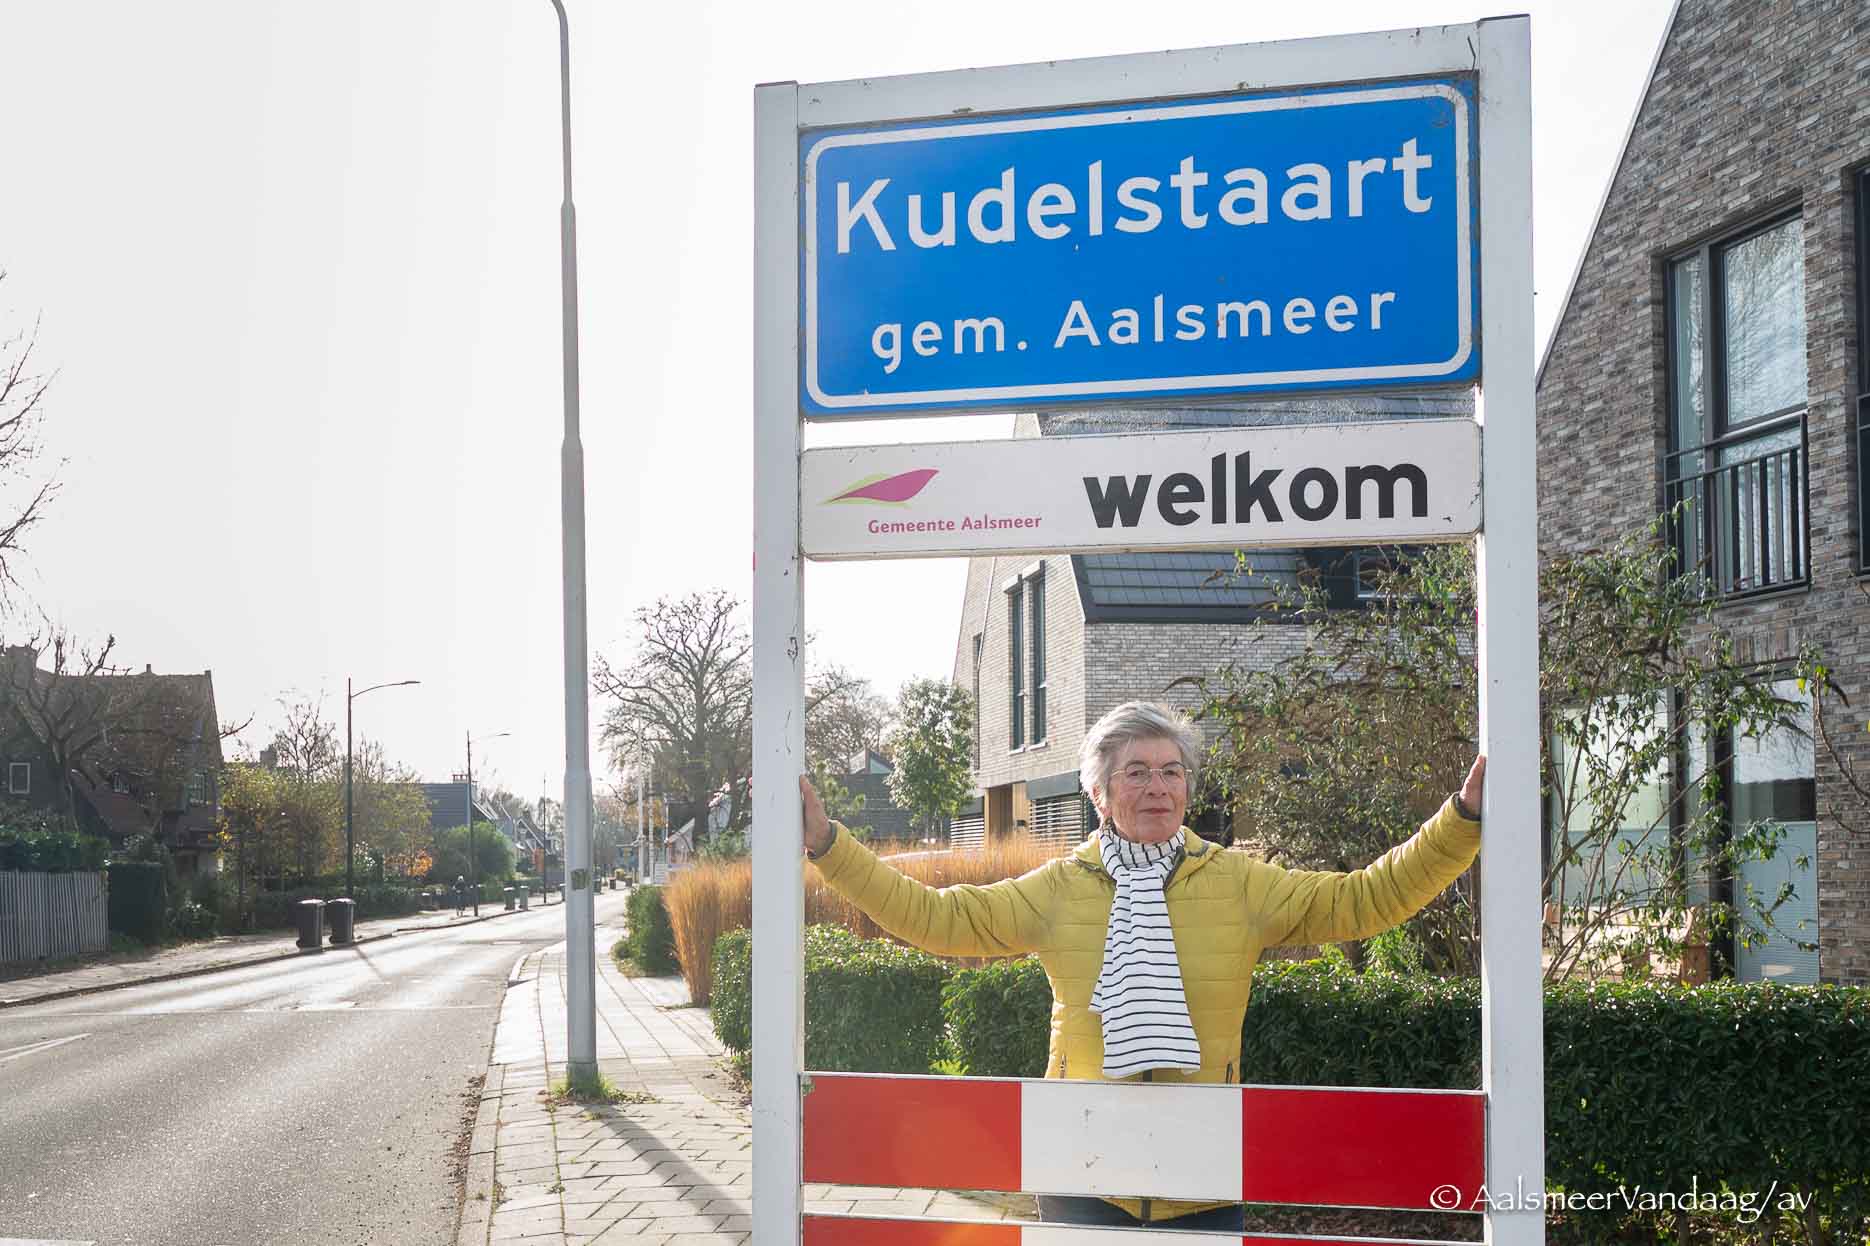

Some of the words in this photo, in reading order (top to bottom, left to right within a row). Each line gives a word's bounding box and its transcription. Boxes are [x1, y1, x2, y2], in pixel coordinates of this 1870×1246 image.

[836, 138, 1433, 255] Kudelstaart
[871, 316, 1028, 374] gem.
[1054, 292, 1396, 348] Aalsmeer
[868, 519, 955, 534] Gemeente
[961, 513, 1042, 531] Aalsmeer
[1083, 451, 1428, 529] welkom
